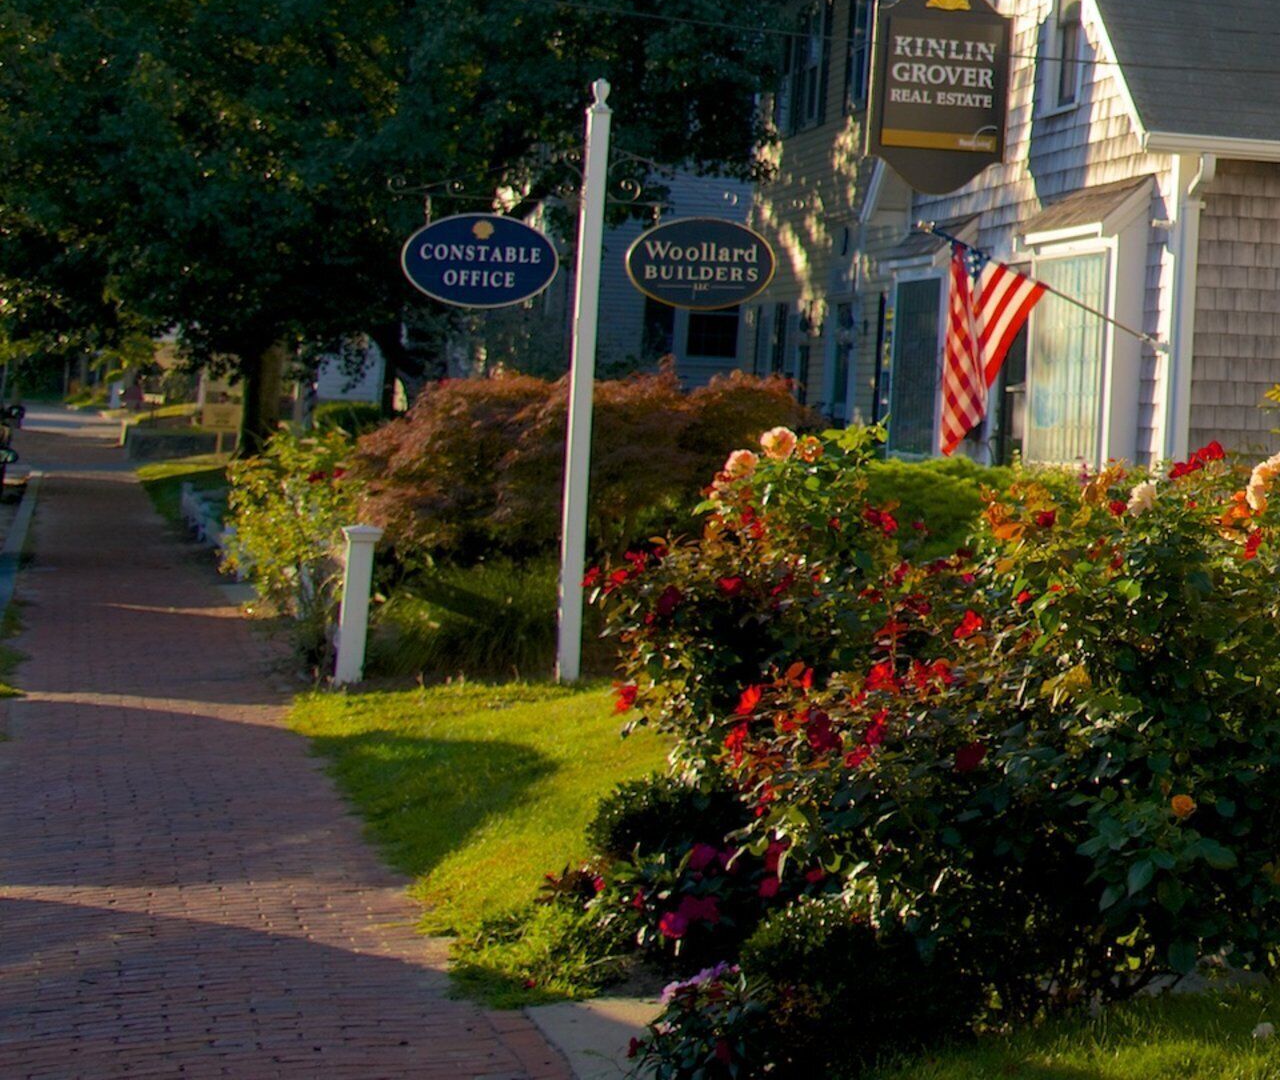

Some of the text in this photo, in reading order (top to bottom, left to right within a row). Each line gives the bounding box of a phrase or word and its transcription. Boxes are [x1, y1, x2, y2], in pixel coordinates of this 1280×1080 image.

[893, 35, 996, 63] KINLIN
[891, 62, 994, 89] GROVER
[890, 88, 993, 108] REAL ESTATE
[419, 243, 542, 264] CONSTABLE
[644, 240, 758, 263] Woollard
[442, 269, 516, 288] OFFICE
[644, 265, 759, 281] BUILDERS
